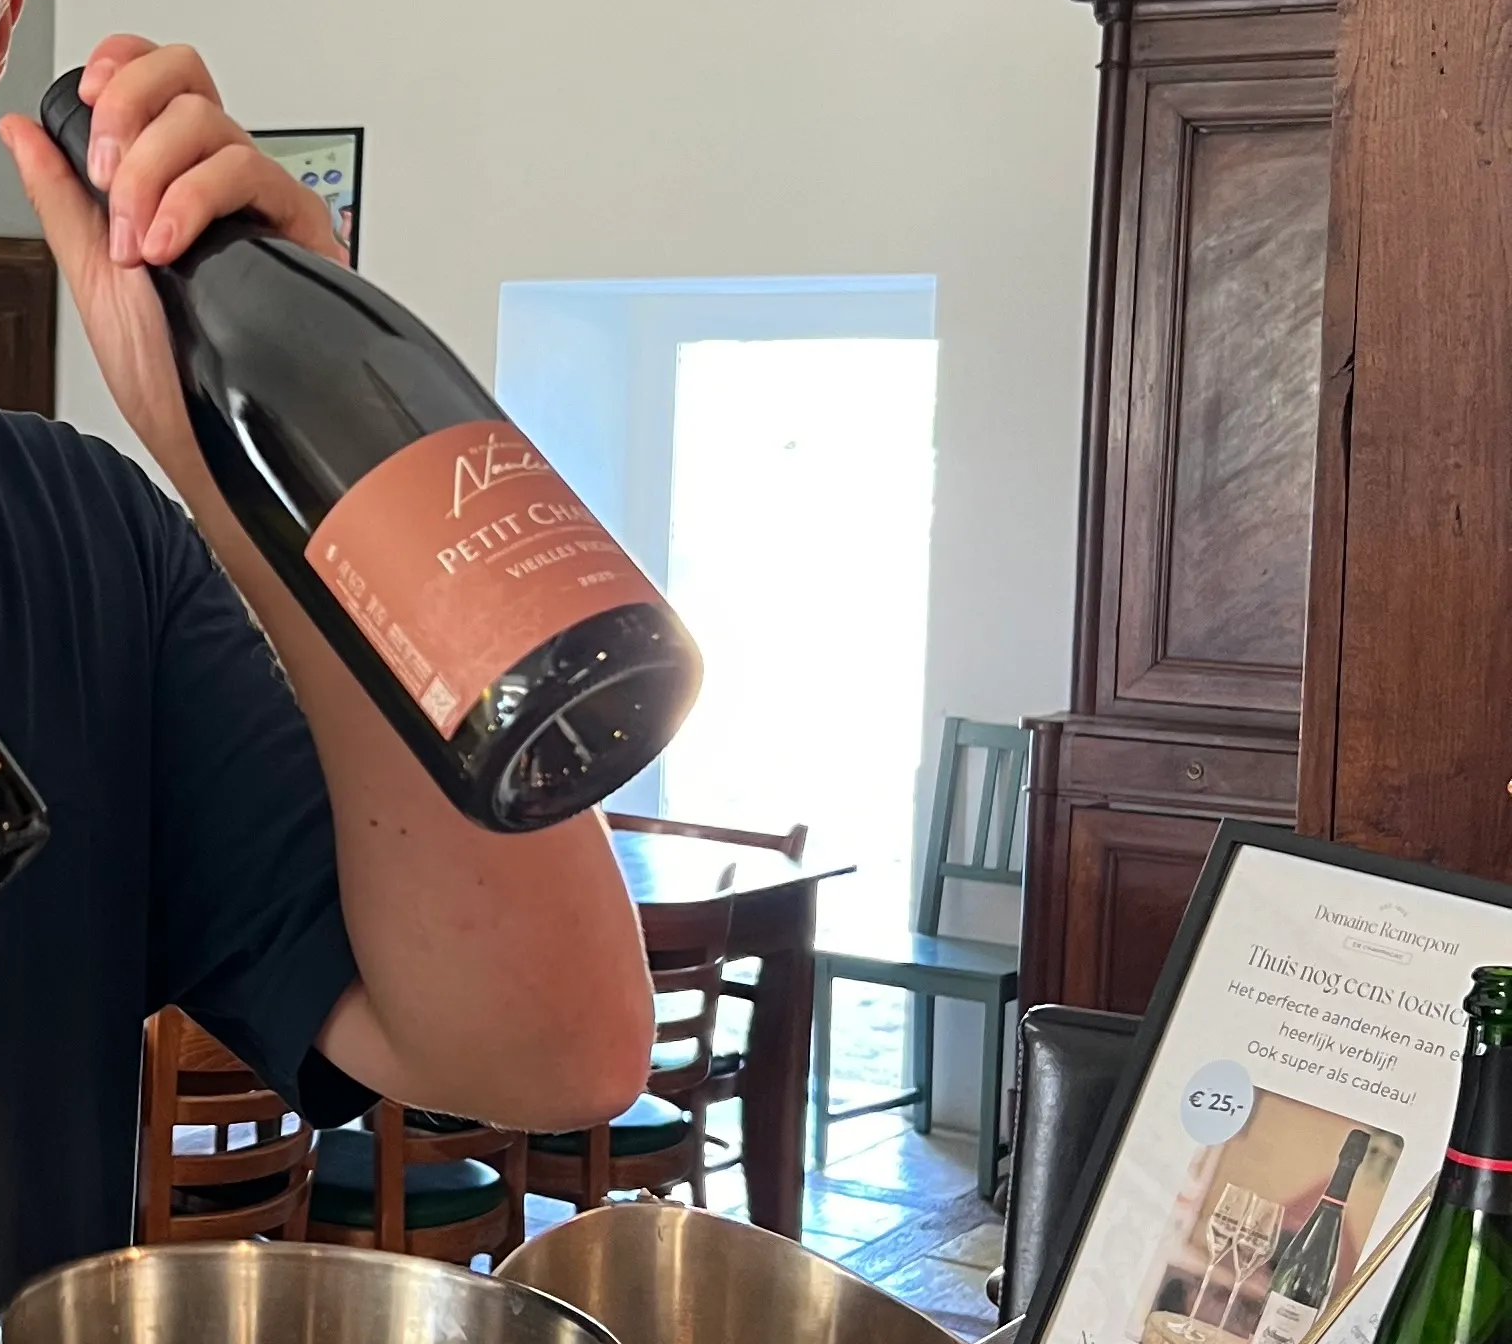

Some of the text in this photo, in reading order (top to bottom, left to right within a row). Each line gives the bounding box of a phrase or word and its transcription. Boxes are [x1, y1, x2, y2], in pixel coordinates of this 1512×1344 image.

[435, 503, 594, 575] PETIT CHA
[505, 543, 577, 579] VIEILLES
[1314, 904, 1378, 935] Domaine
[1379, 921, 1460, 956] Rennepont
[1247, 944, 1299, 978] Thuis
[1299, 962, 1342, 995] nog
[1344, 977, 1393, 1005] eens
[1228, 980, 1255, 1000] Het
[1256, 988, 1319, 1018] perfecte
[1321, 1010, 1412, 1046] aandenken
[1414, 1038, 1445, 1058] aan
[1278, 1021, 1399, 1072] heerlijk verblijf!
[1247, 1040, 1417, 1106] Ook super als cadeau!
[1188, 1090, 1244, 1116] € 25,-
